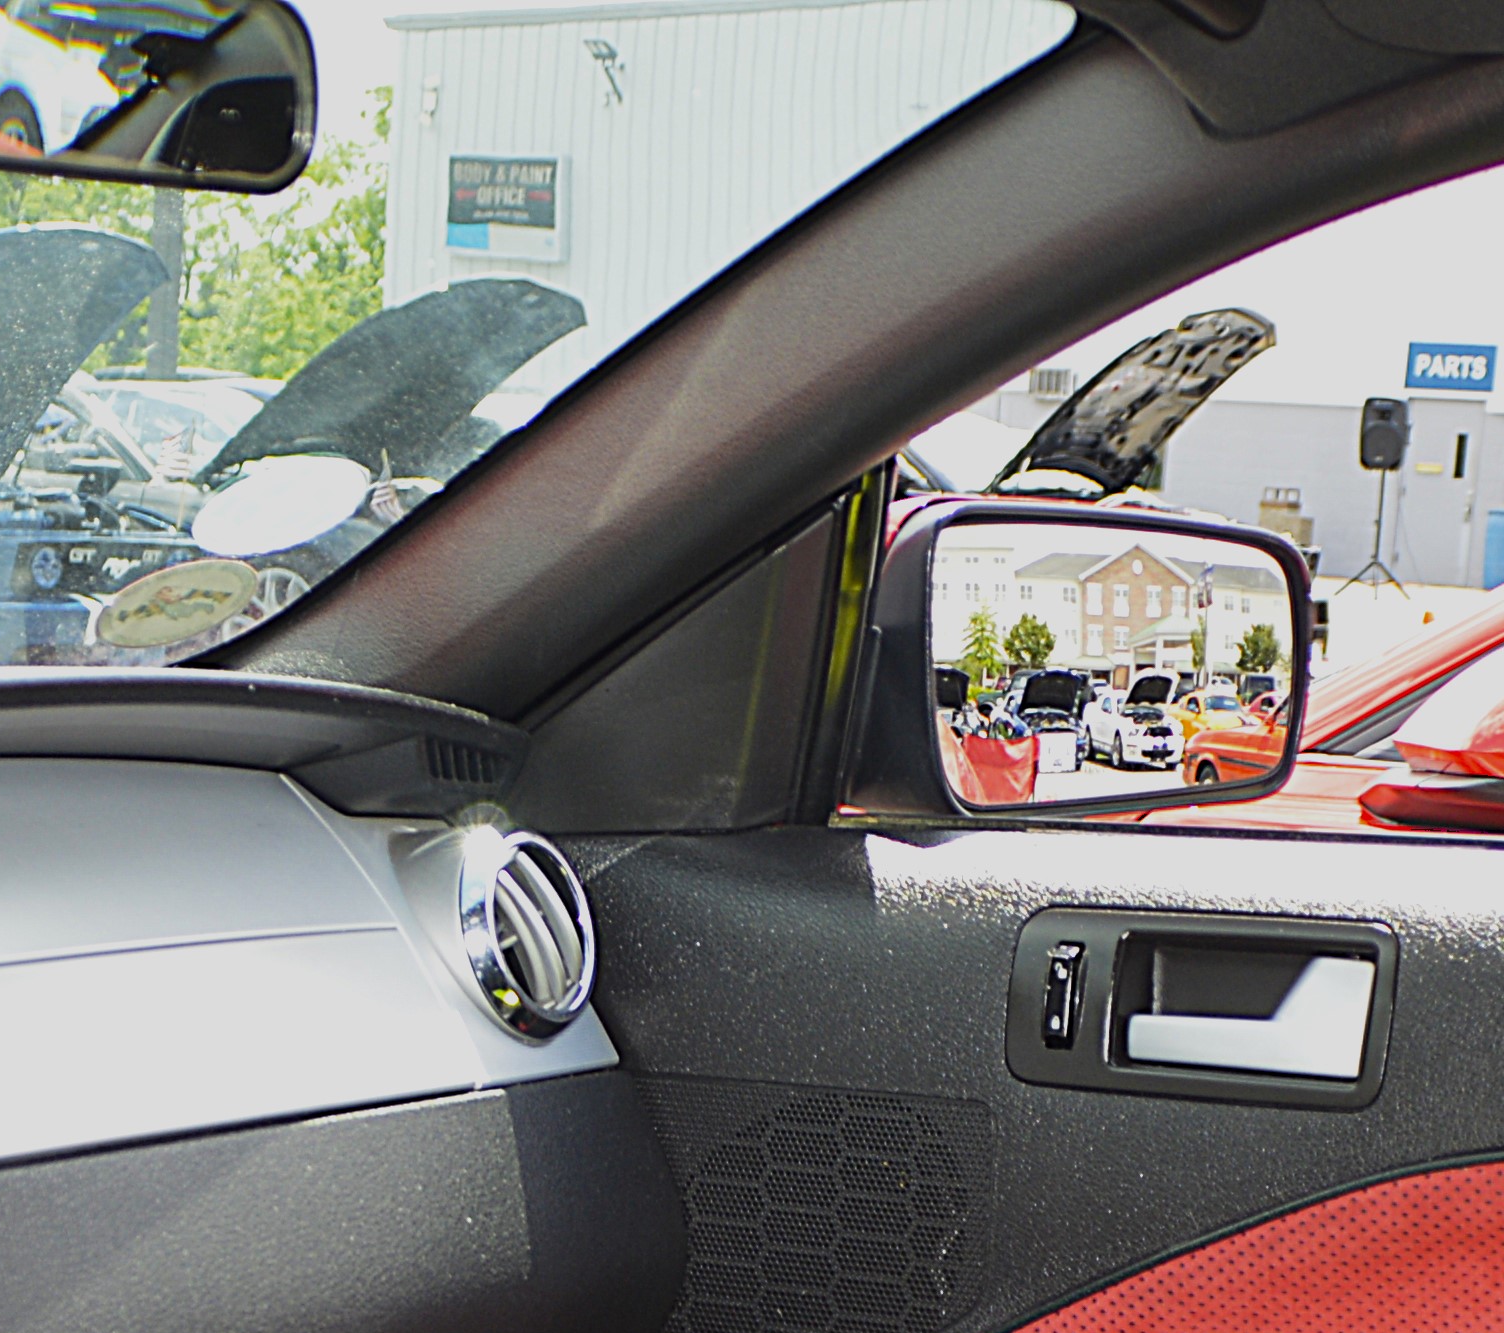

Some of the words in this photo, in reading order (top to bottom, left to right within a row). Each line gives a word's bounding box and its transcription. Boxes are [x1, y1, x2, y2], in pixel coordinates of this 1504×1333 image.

[453, 161, 491, 183] BODY
[510, 163, 553, 184] PAINT
[476, 185, 526, 206] OFFICE
[1414, 353, 1488, 381] PARTS
